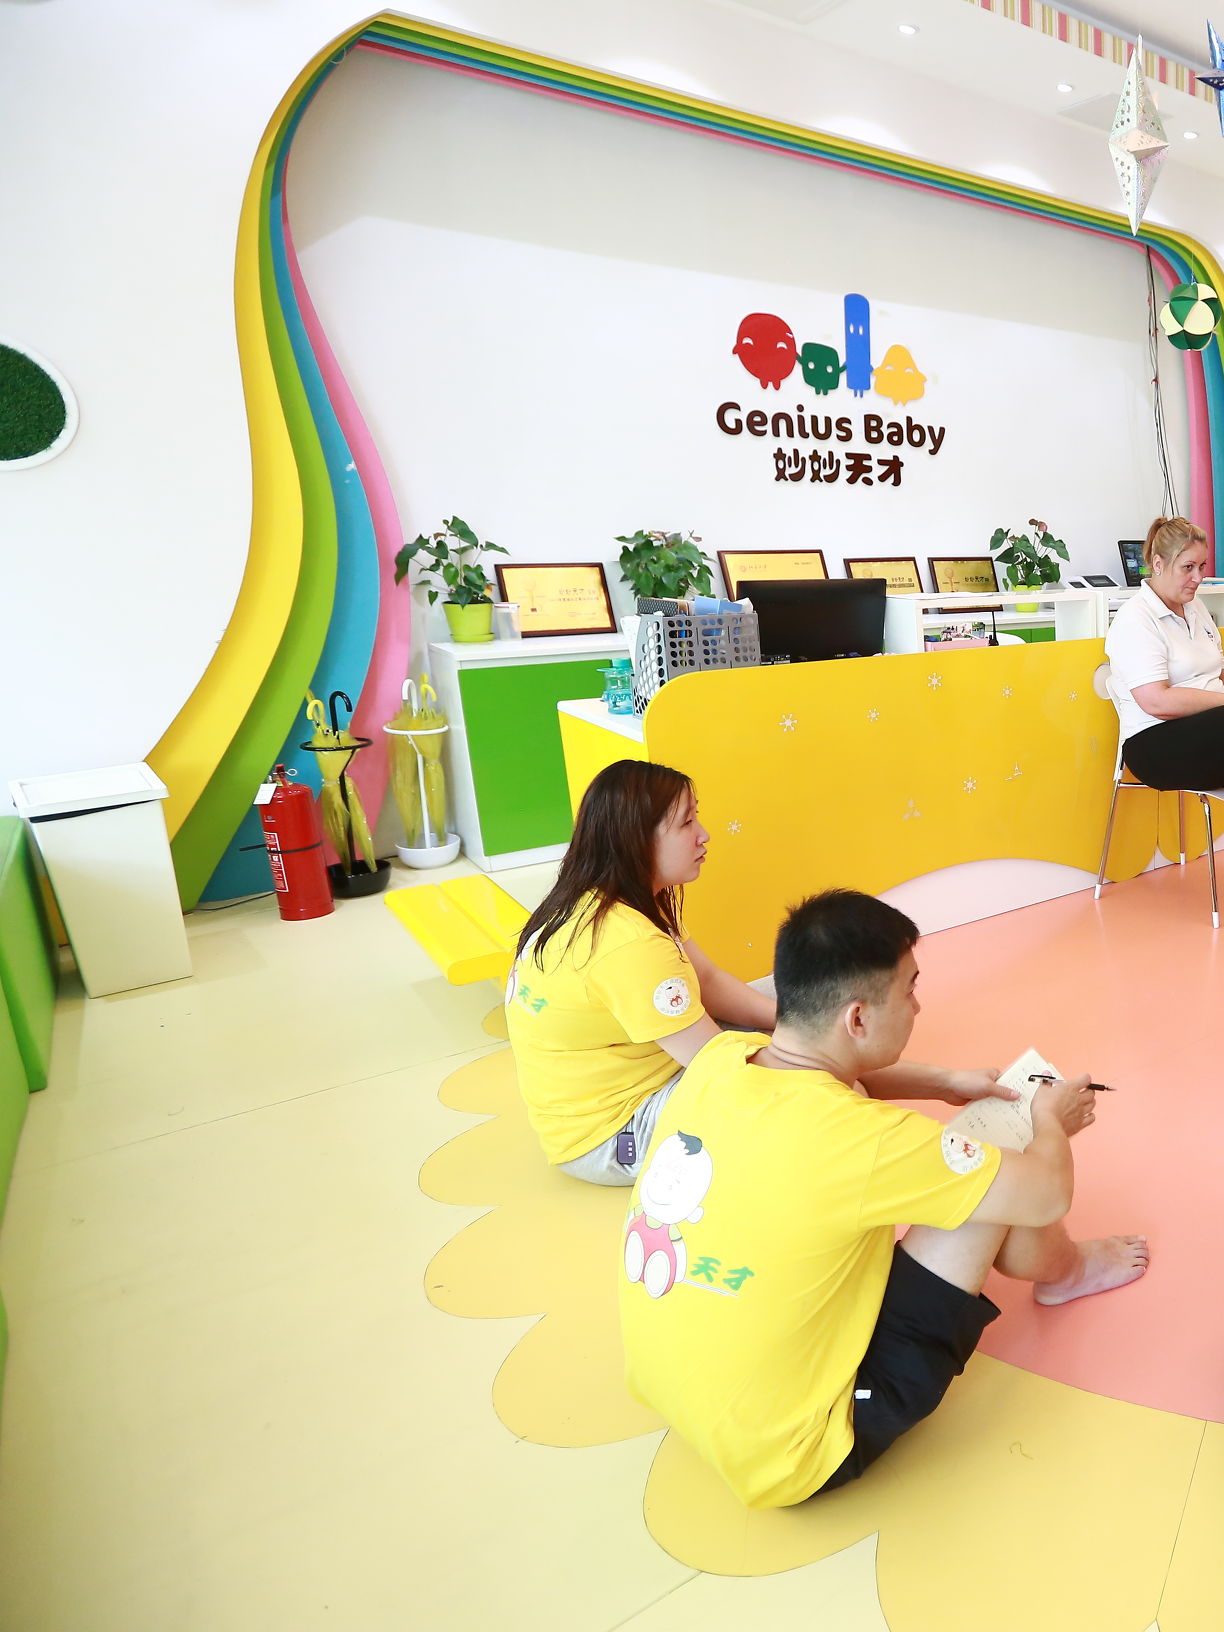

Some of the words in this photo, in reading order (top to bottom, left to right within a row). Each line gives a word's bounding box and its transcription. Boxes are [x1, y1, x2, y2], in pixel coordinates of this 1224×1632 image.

[715, 401, 853, 443] Genius
[863, 413, 946, 456] Baby
[772, 446, 905, 487] 妙妙天才
[689, 1255, 756, 1292] 天才
